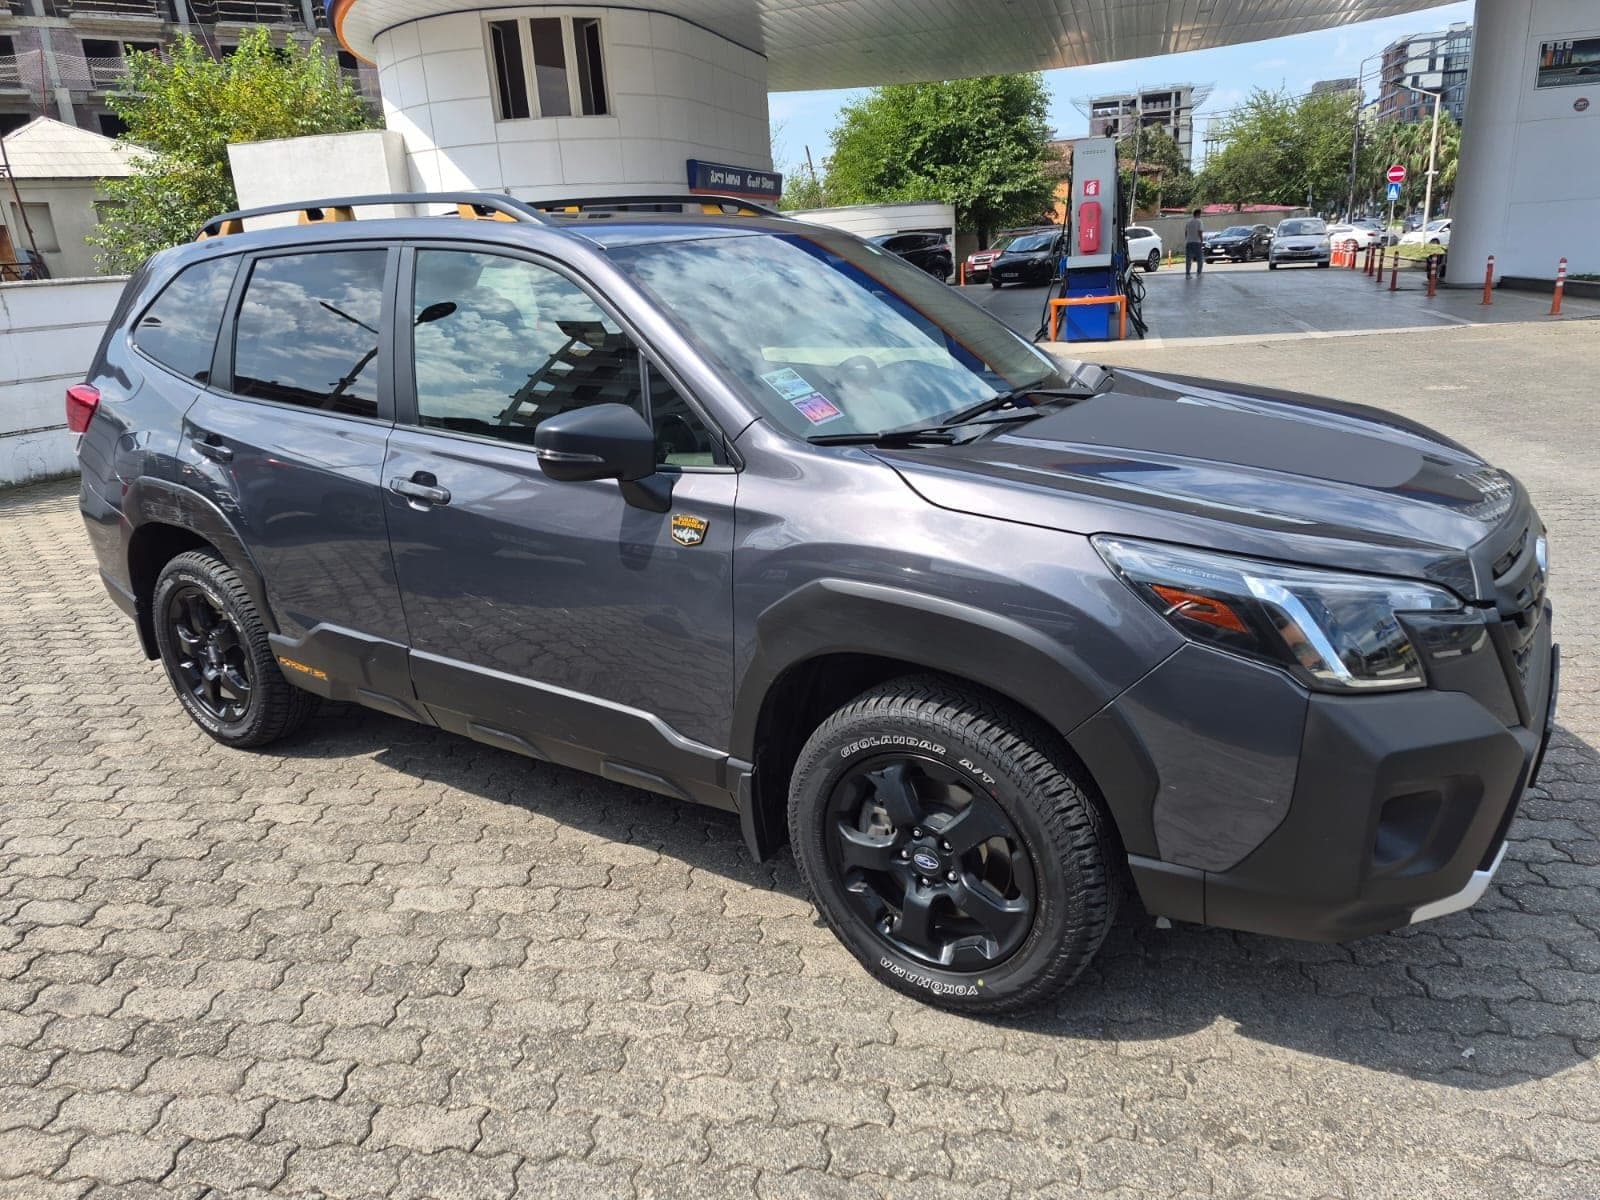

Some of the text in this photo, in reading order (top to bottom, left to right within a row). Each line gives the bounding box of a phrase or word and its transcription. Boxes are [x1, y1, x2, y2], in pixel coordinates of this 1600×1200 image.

[840, 735, 995, 784] GEOLANDAR A/T
[880, 956, 979, 995] YOKOHAMA
